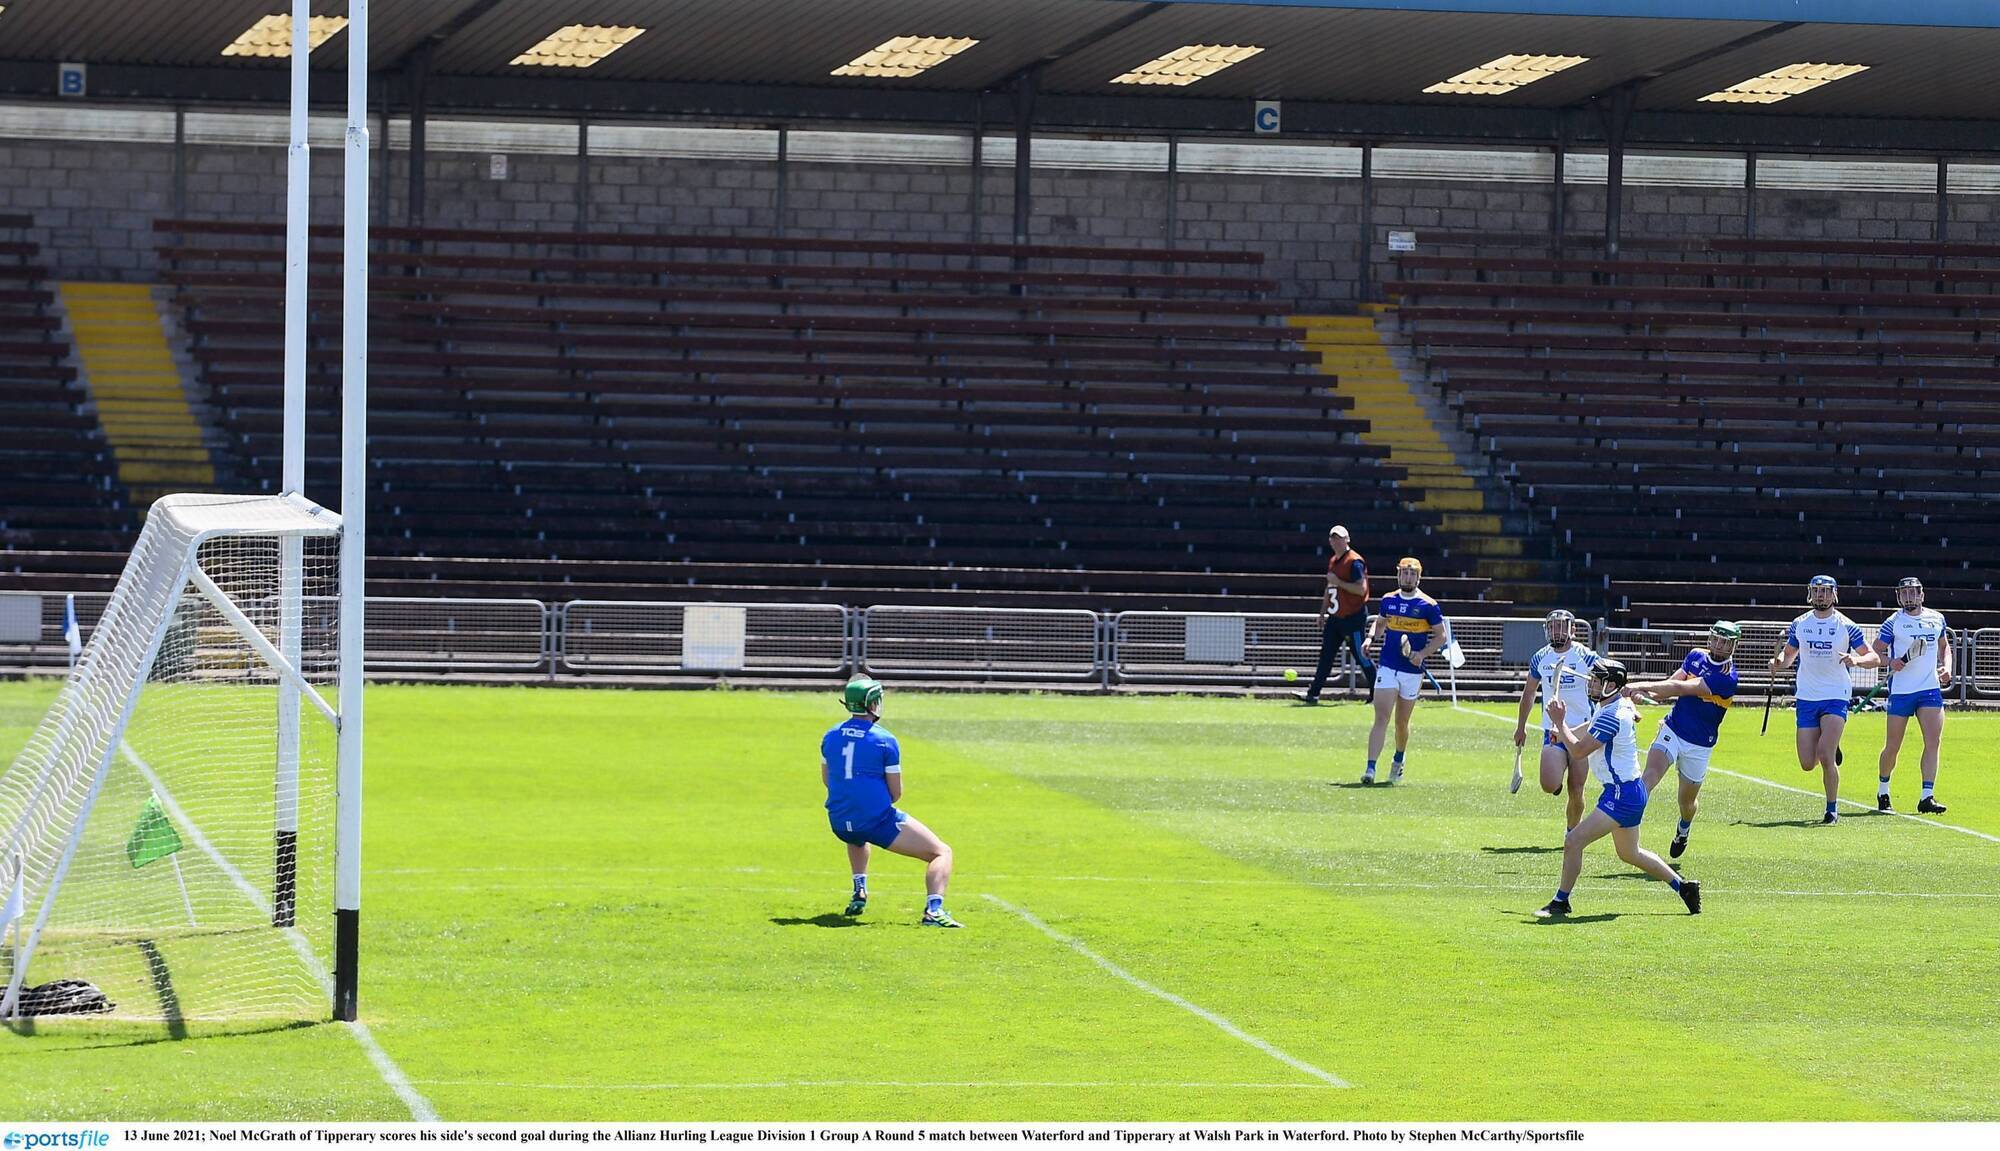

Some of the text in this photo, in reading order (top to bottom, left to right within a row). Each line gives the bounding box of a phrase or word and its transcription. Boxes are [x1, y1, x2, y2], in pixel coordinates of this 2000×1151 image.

[63, 70, 82, 93] B
[1257, 107, 1278, 130] C
[1327, 588, 1339, 614] 3
[1806, 640, 1833, 650] TQS
[840, 727, 866, 738] TQS
[841, 741, 855, 780] 1
